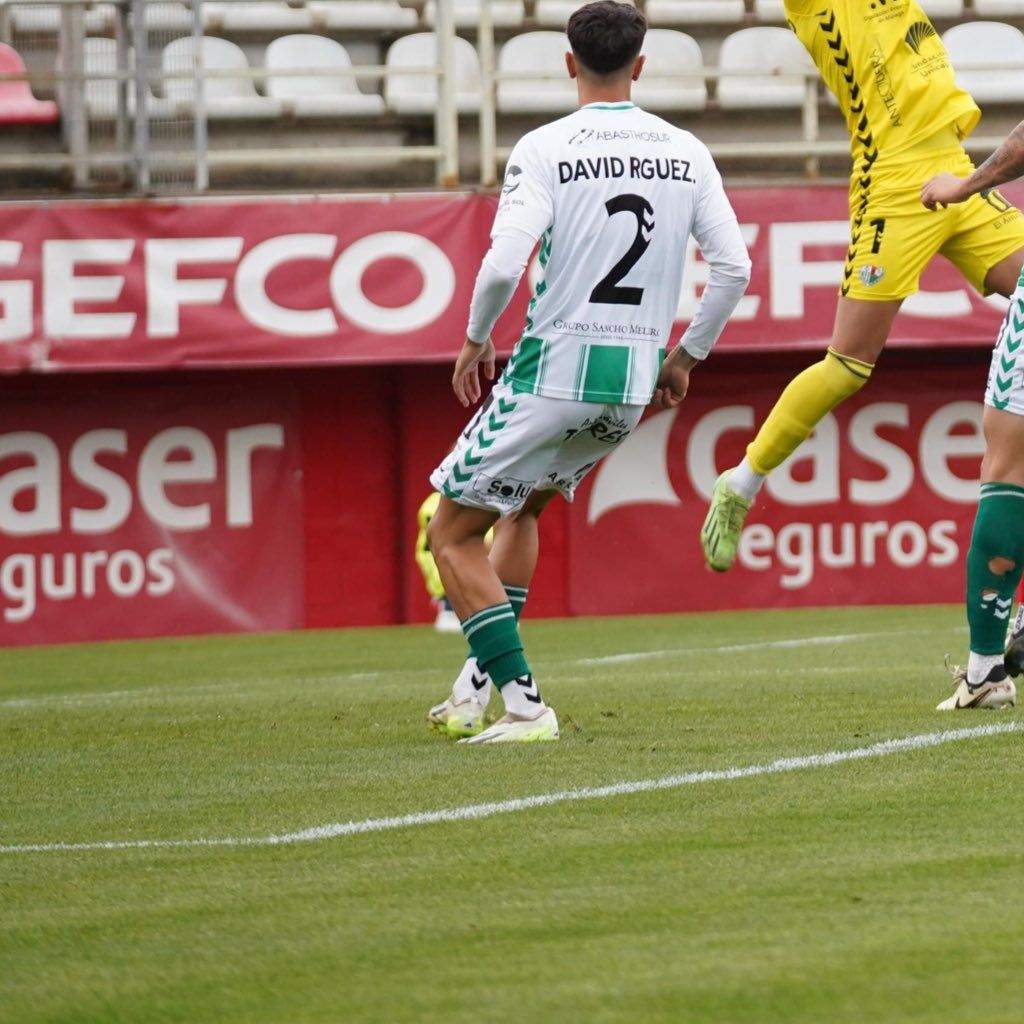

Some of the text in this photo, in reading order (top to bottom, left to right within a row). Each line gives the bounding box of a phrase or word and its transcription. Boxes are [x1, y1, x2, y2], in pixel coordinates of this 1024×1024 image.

[558, 156, 626, 184] DAVID
[588, 193, 656, 305] 2
[869, 218, 886, 254] 1
[1, 547, 175, 622] guros
